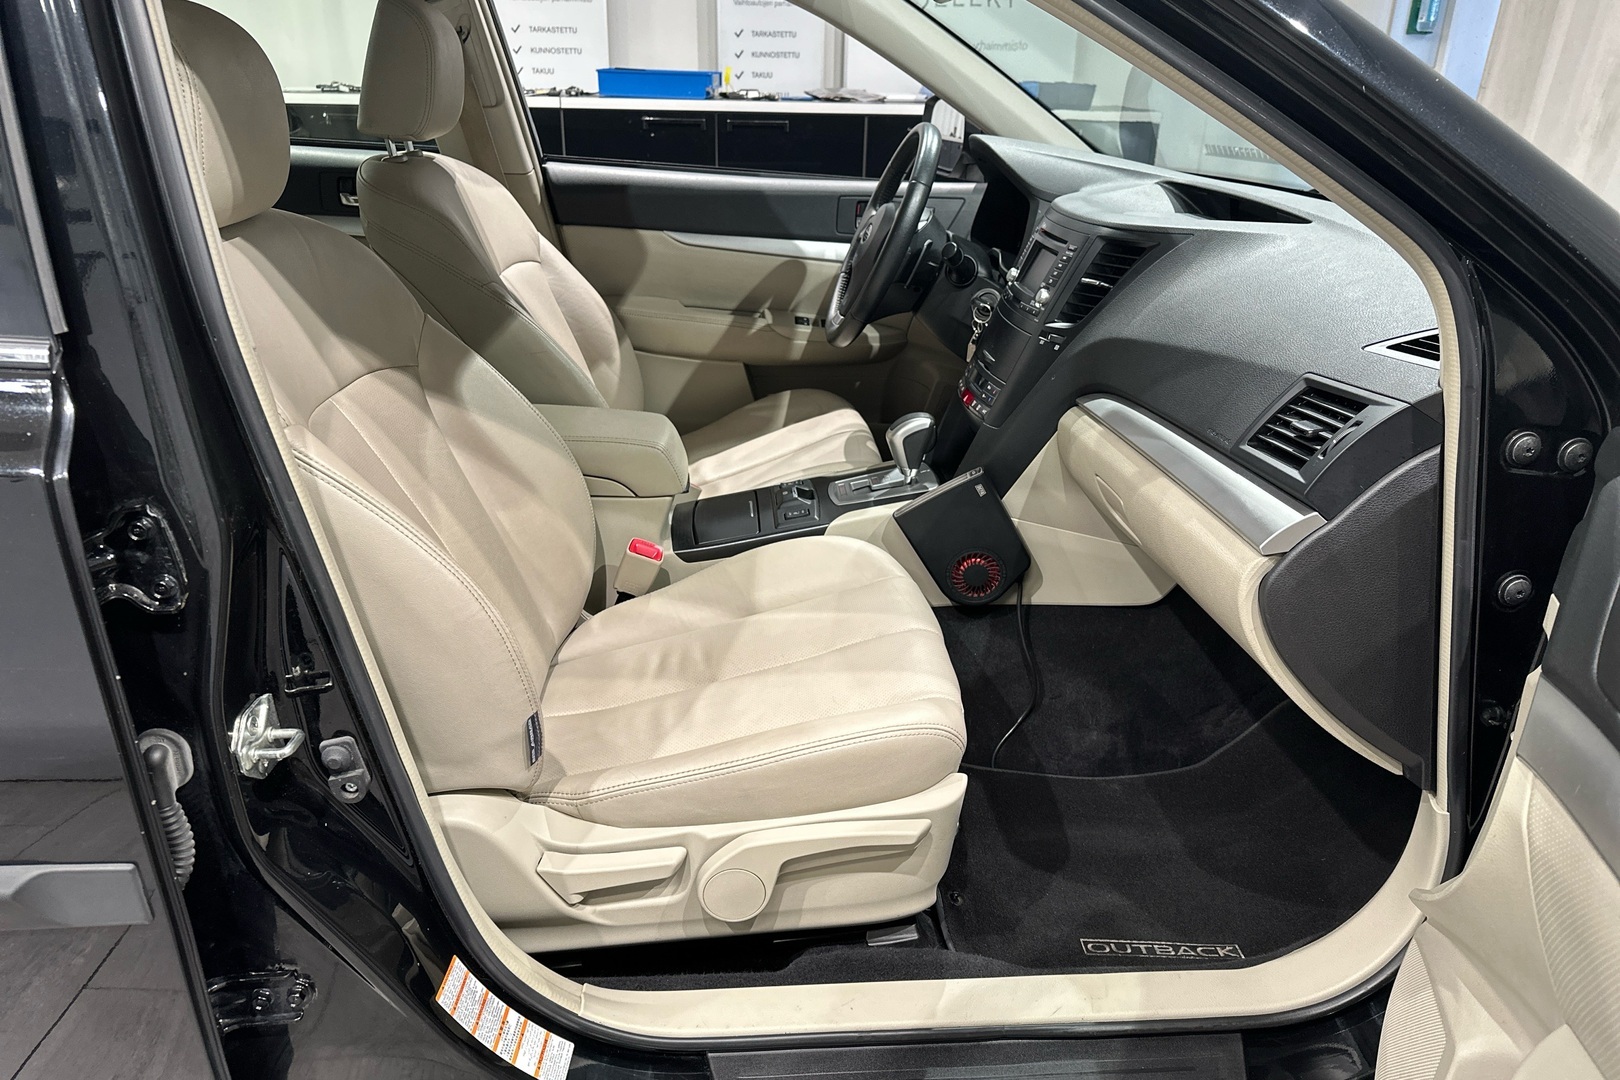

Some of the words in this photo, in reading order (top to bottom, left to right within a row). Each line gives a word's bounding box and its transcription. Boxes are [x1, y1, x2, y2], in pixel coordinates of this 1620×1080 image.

[529, 26, 577, 34] TARKASTETTU
[751, 30, 797, 38] TARKASTETTU
[530, 47, 582, 55] KUNNOSTETTU
[751, 51, 800, 59] KUNNOSTETTU
[532, 67, 555, 75] TAKUU
[751, 71, 773, 79] TAKUU
[1087, 943, 1240, 958] OUTBACK
